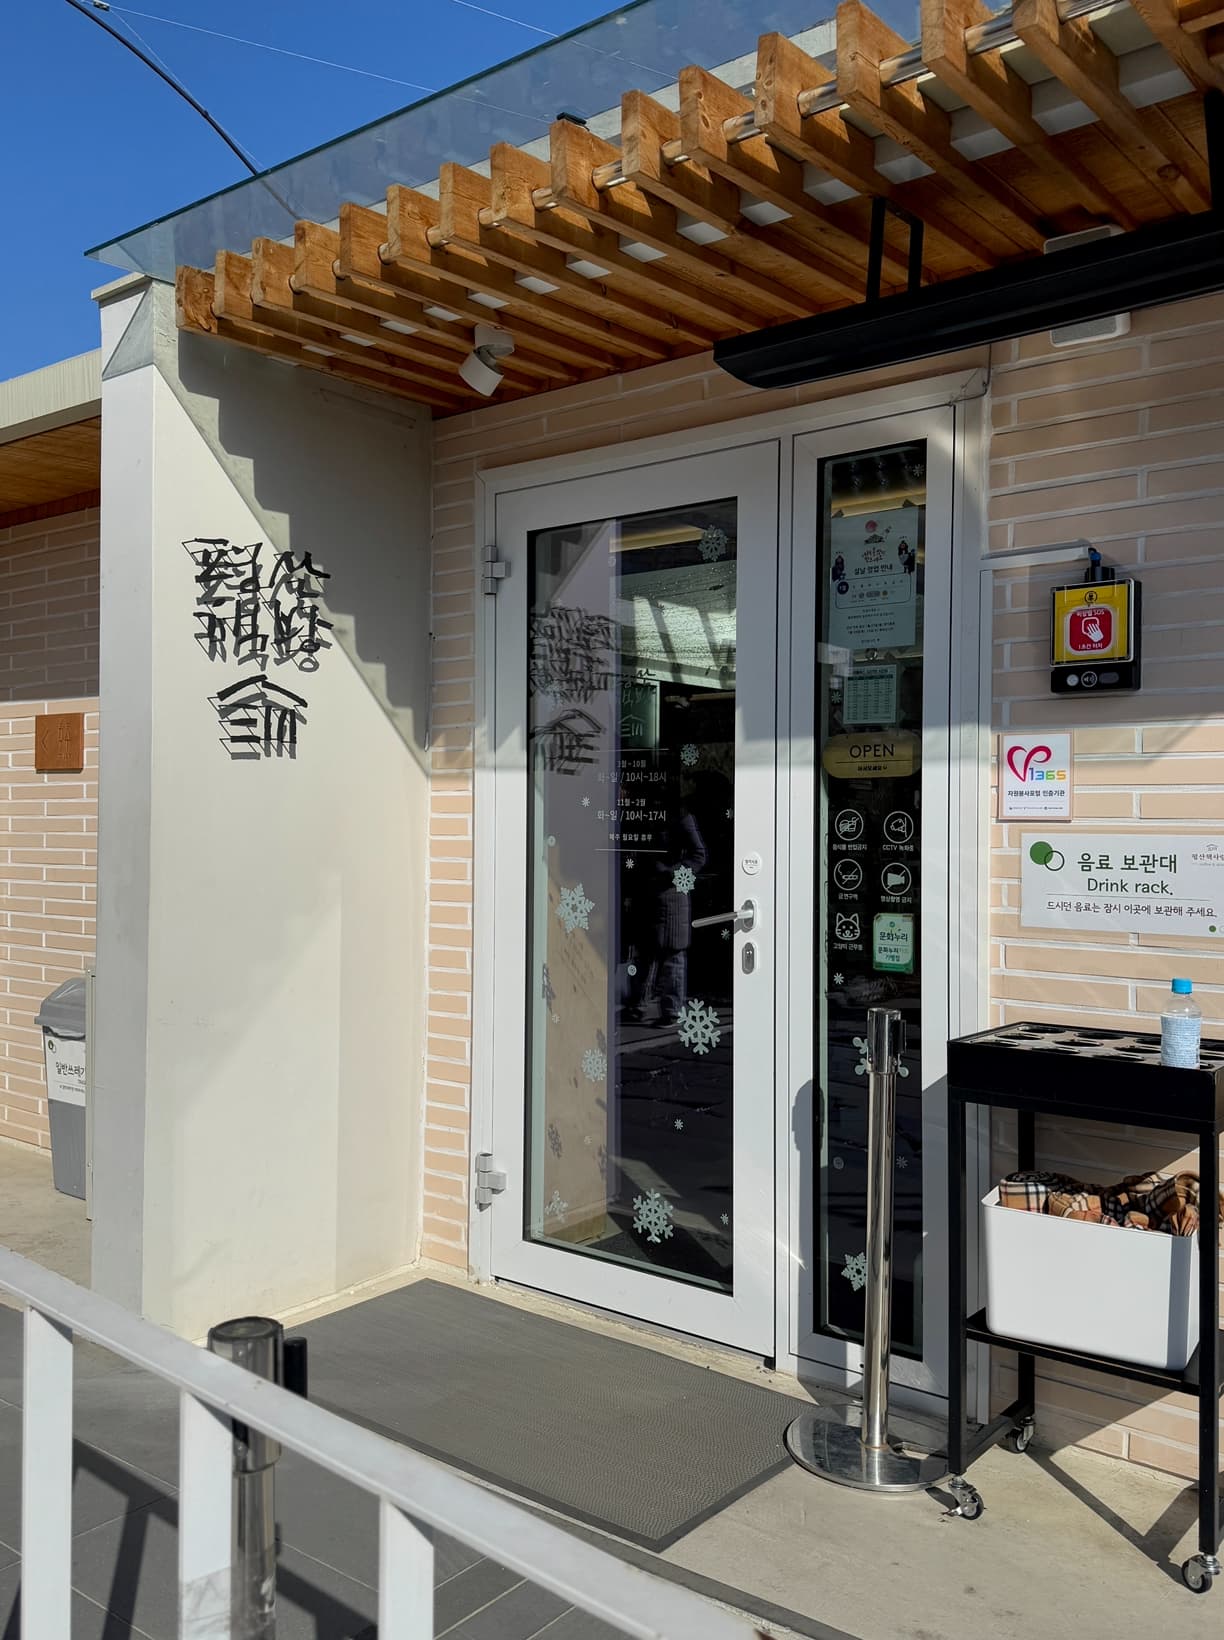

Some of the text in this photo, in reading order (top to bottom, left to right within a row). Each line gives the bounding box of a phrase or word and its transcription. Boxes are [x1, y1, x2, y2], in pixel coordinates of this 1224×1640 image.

[849, 743, 895, 758] OPEN
[1028, 767, 1067, 781] 1365
[1077, 852, 1177, 874] 음료 보관대
[1087, 877, 1174, 895] Drink rack.
[838, 893, 859, 901] 금연구역
[1046, 901, 1218, 918] 드시던 음료는 잠시 이곳에 보관해 주세요.
[879, 930, 908, 942] 문화누리
